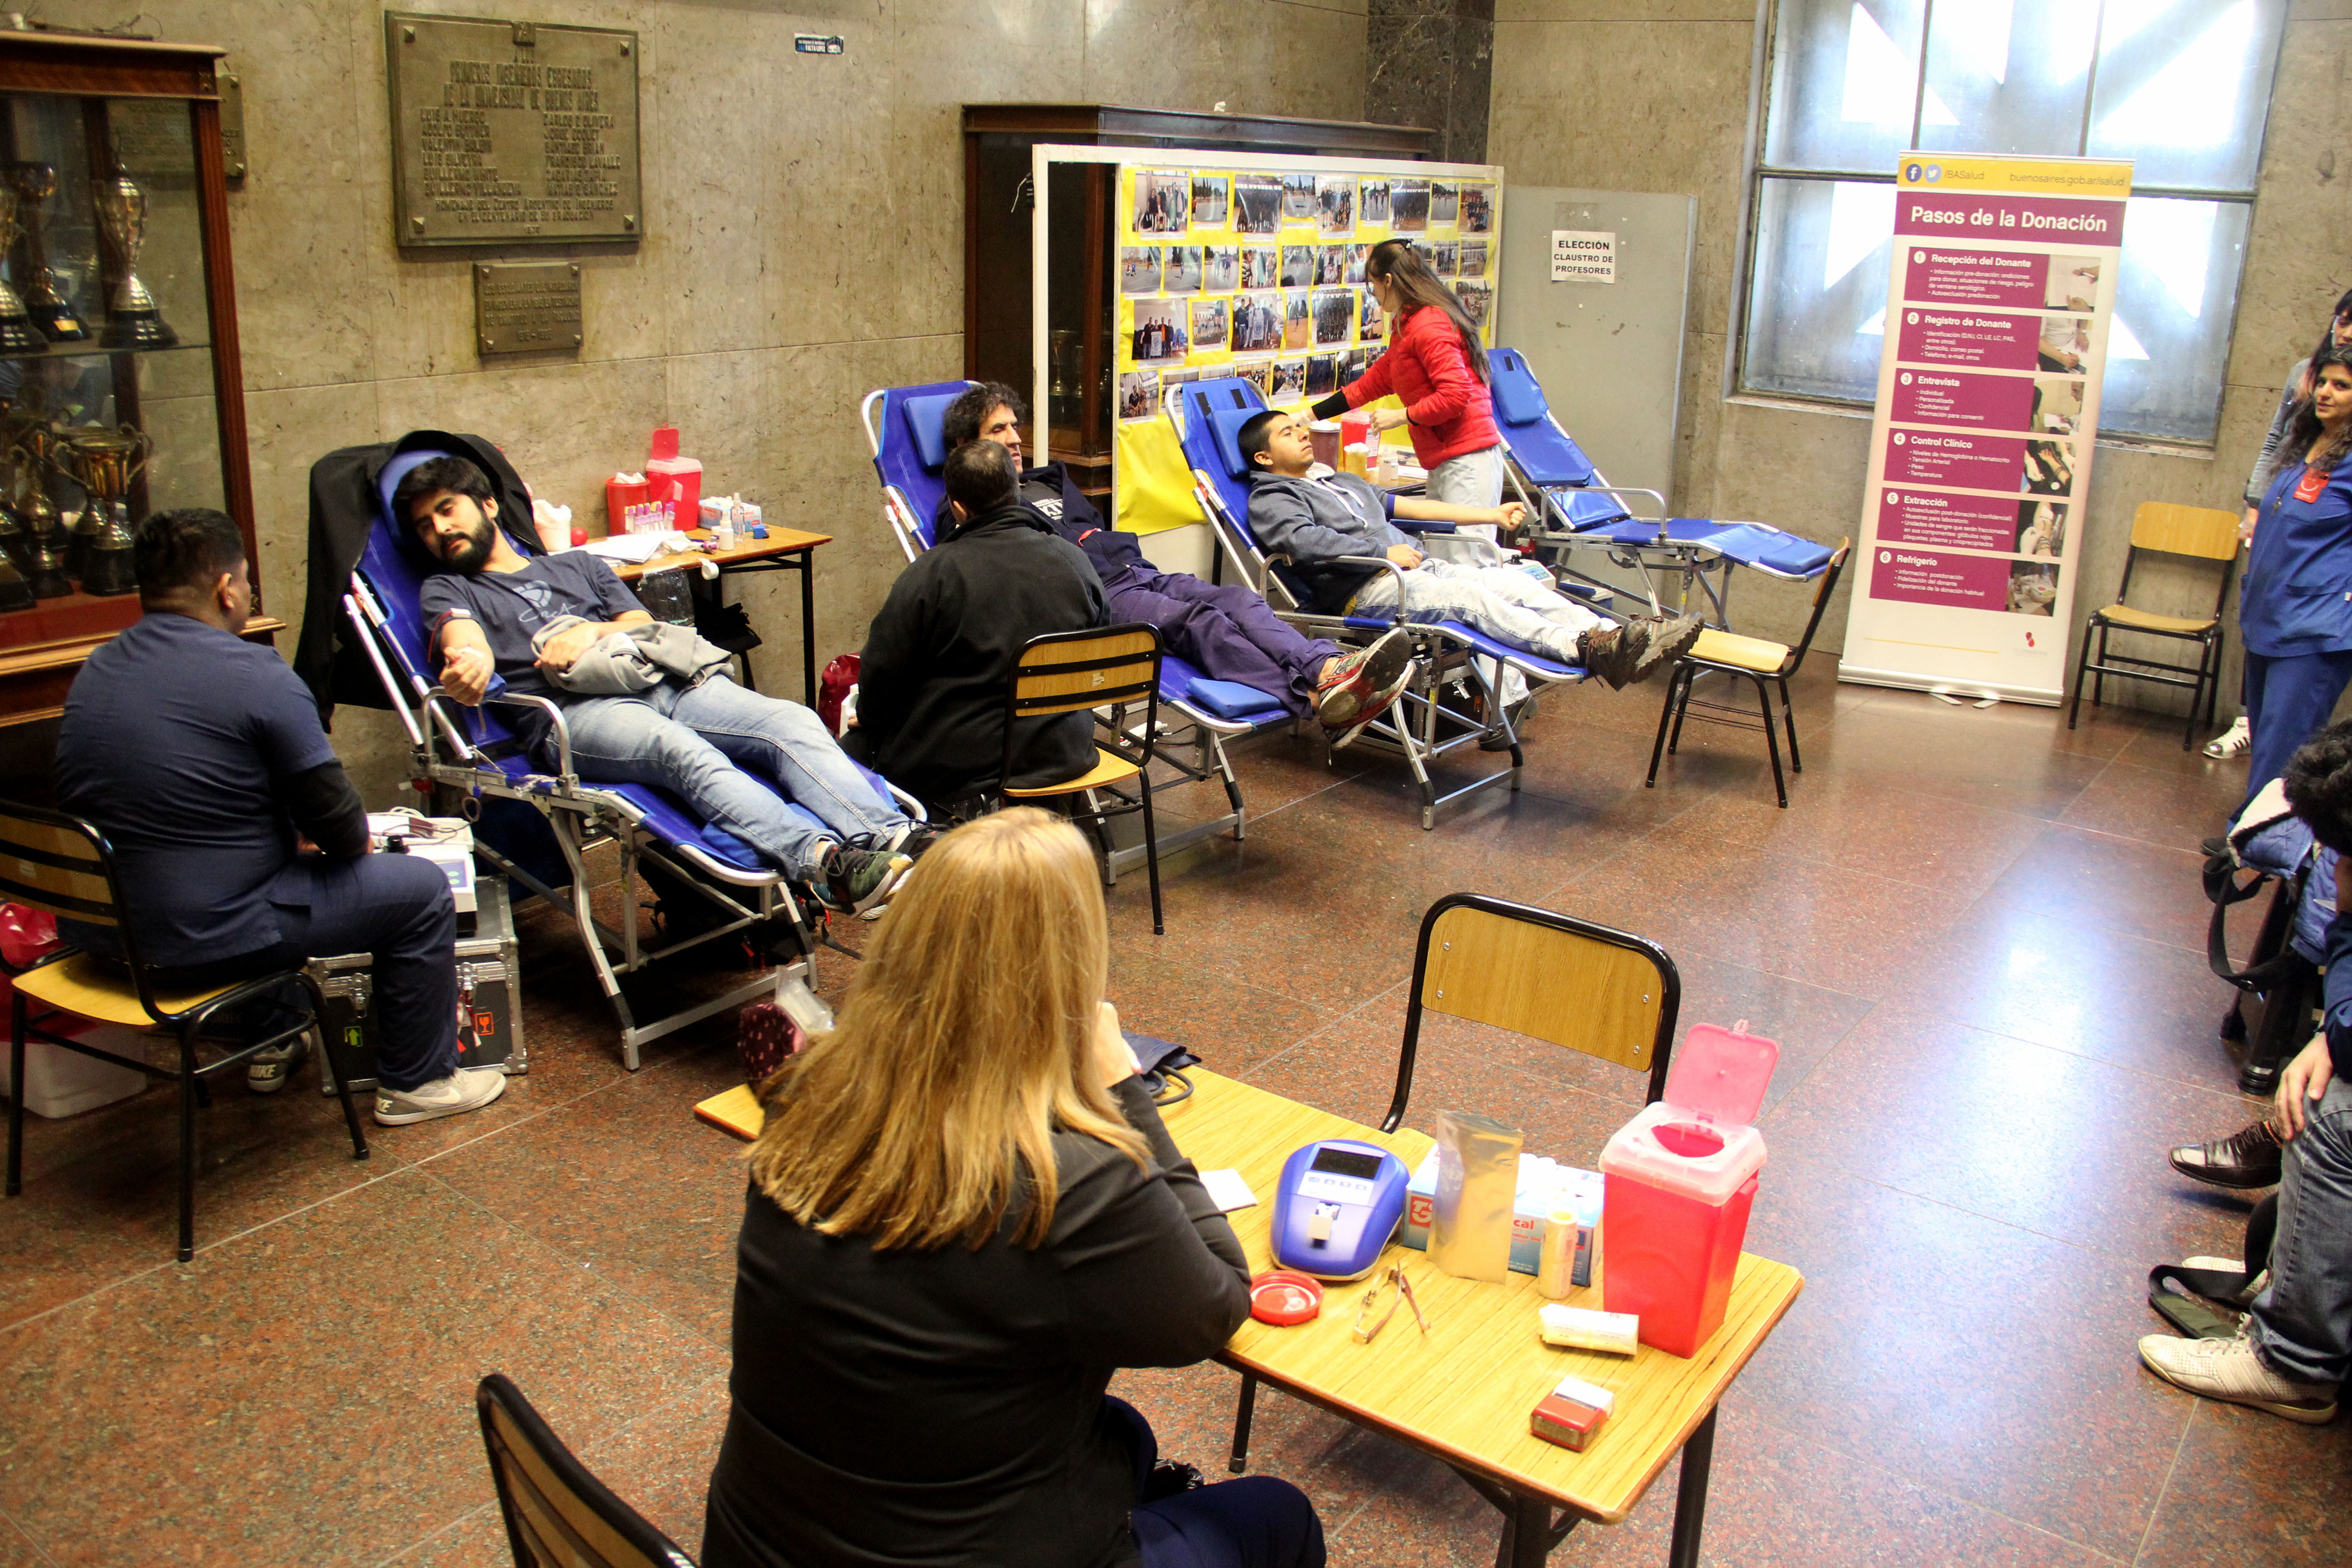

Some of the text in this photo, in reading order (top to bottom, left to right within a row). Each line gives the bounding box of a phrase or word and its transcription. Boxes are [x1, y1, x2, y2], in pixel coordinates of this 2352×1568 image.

[1944, 170, 1984, 179] /BASalud
[2010, 173, 2124, 186] buenosaires.gob.ar/salud
[1911, 206, 2107, 232] Pasos de la Donación
[1559, 240, 1609, 250] ELECCIÓN
[1931, 254, 1977, 265] Recepción
[1979, 256, 1993, 265] del
[1995, 258, 2031, 268] Donante
[1556, 265, 1611, 274] PROFESORES
[1925, 315, 1960, 327] Registro
[1962, 318, 1974, 326] de
[1975, 318, 2011, 328] Donante
[1918, 376, 1960, 387] Entrevista
[1911, 436, 1941, 446] Control
[1943, 438, 1972, 449] Clínico
[1904, 495, 1948, 507] Extracción
[1896, 554, 1938, 567] Refrigerio
